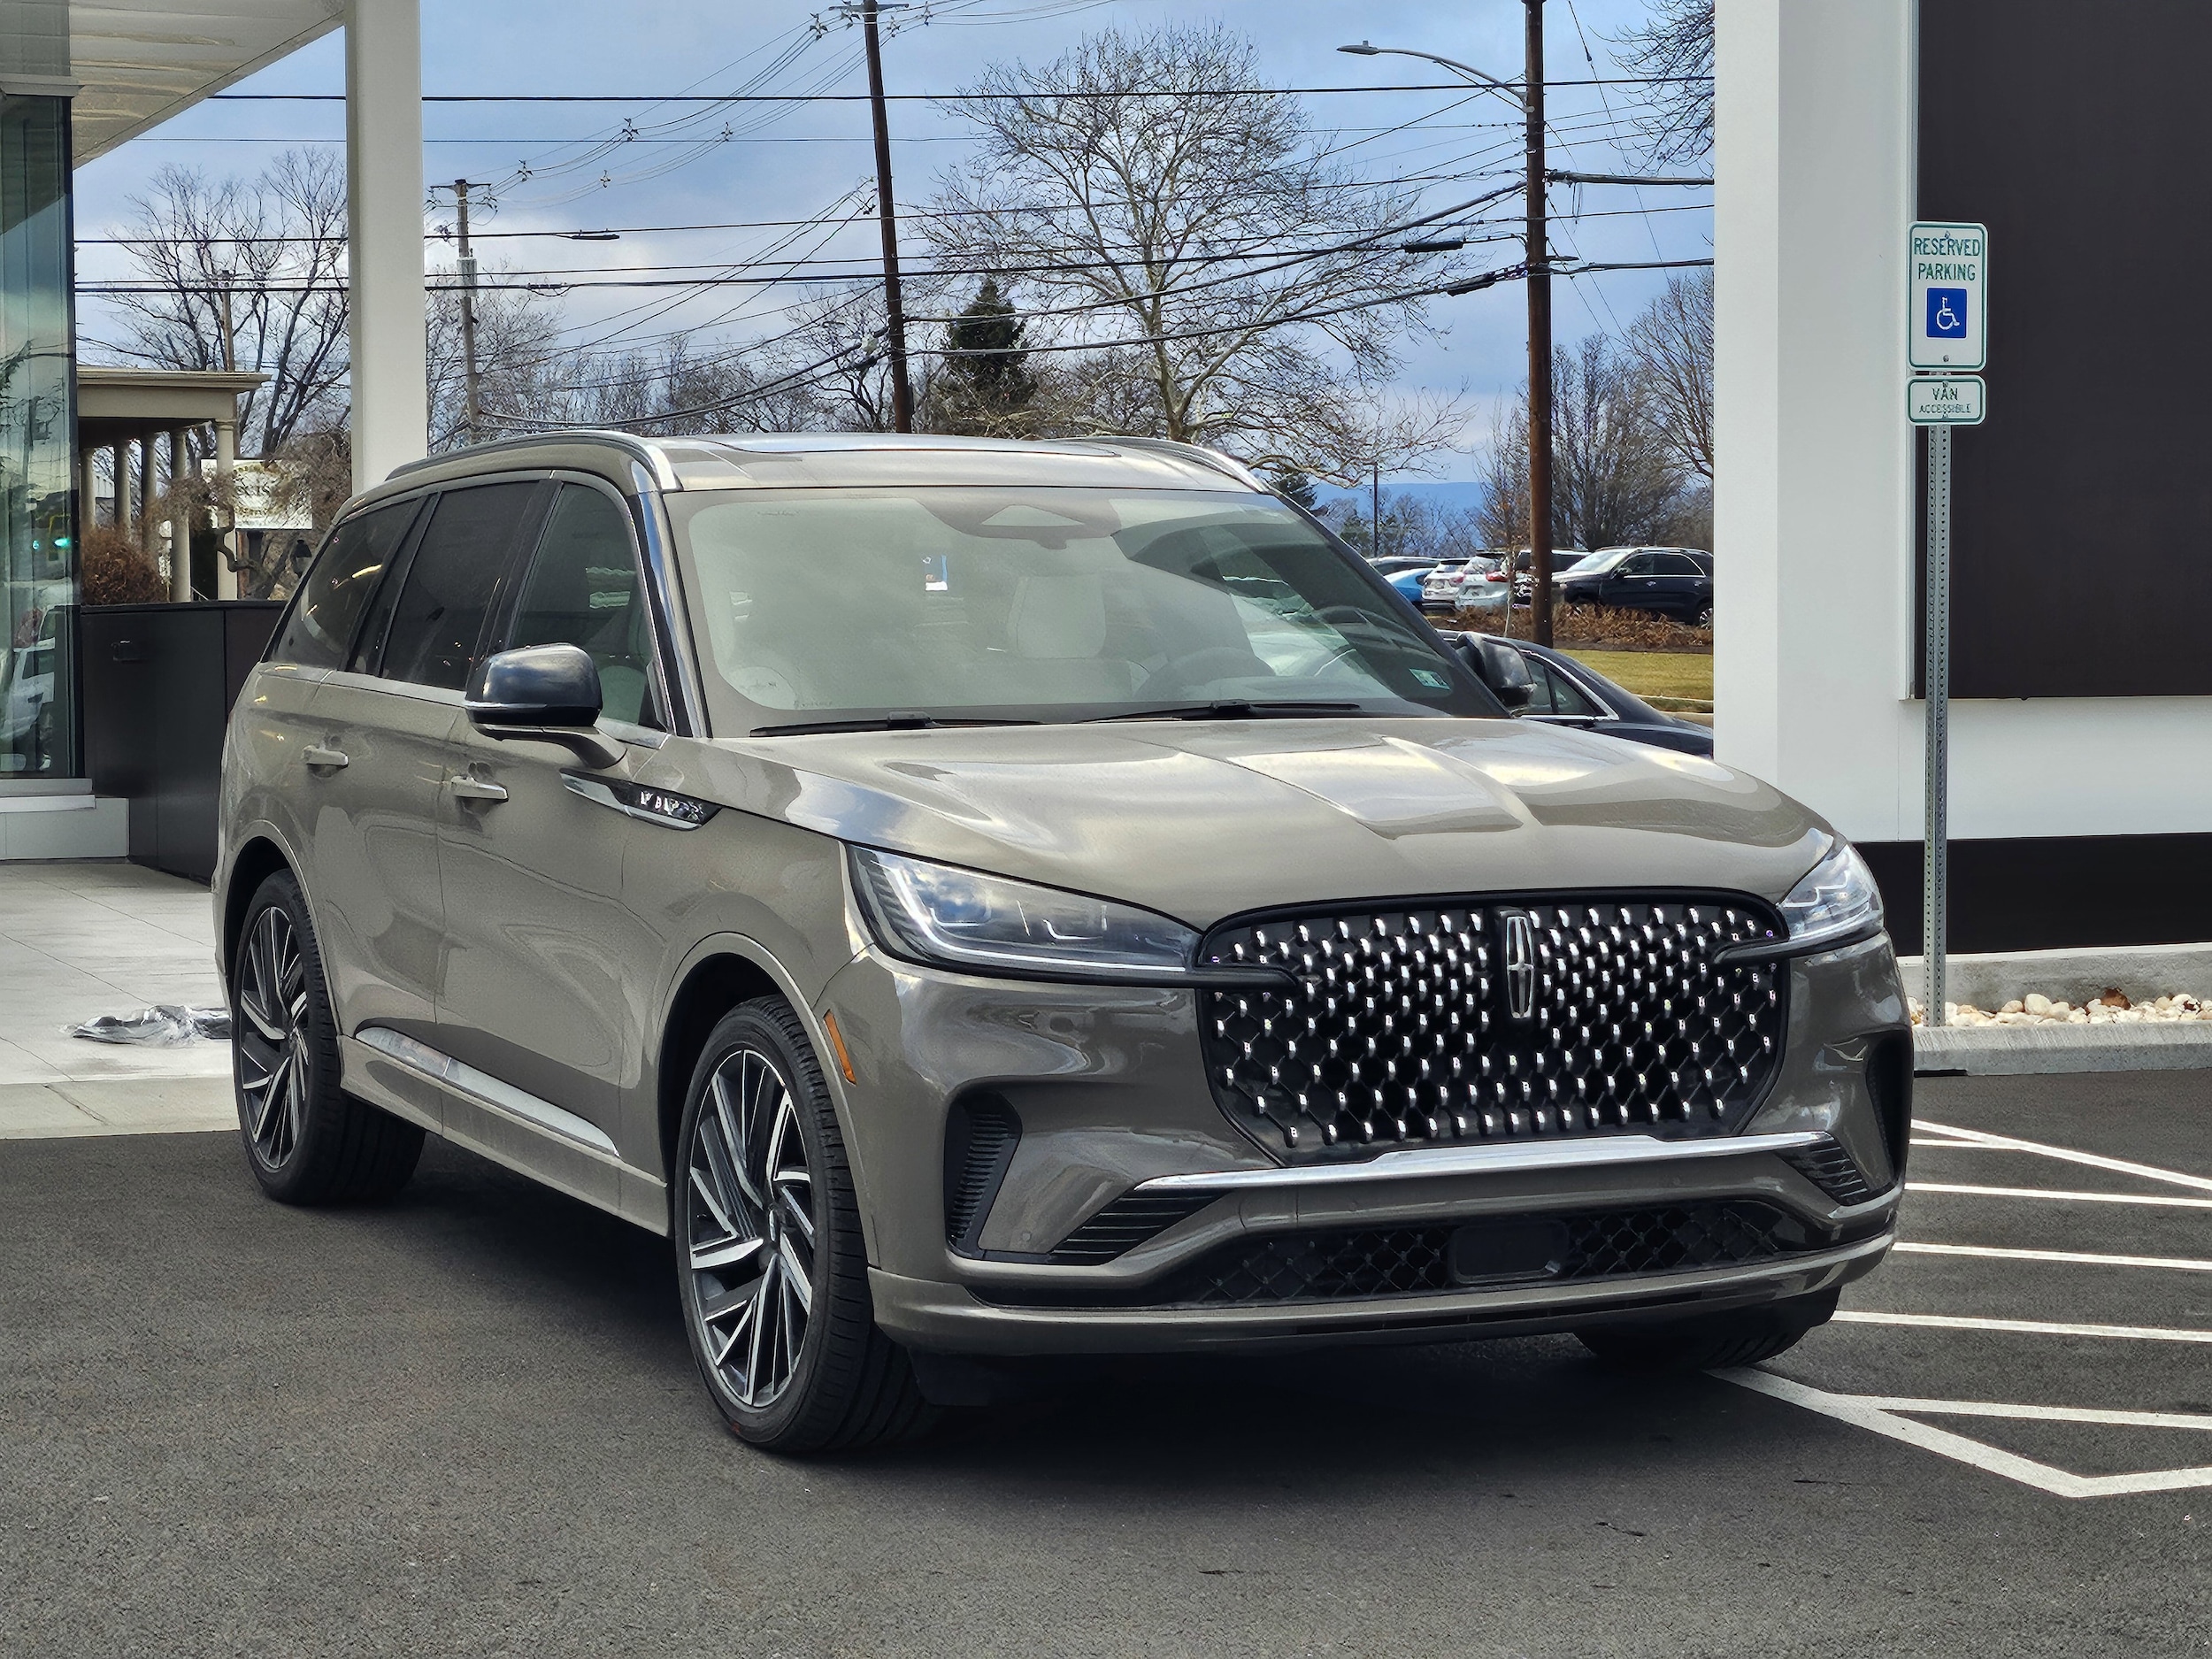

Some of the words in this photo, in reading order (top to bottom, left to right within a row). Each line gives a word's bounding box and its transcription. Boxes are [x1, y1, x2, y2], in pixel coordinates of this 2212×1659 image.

[1914, 237, 1980, 257] RESERVED
[1917, 263, 1976, 281] PARKING
[1932, 388, 1958, 401] VAN
[1918, 403, 1971, 414] ACCESSIBLE
